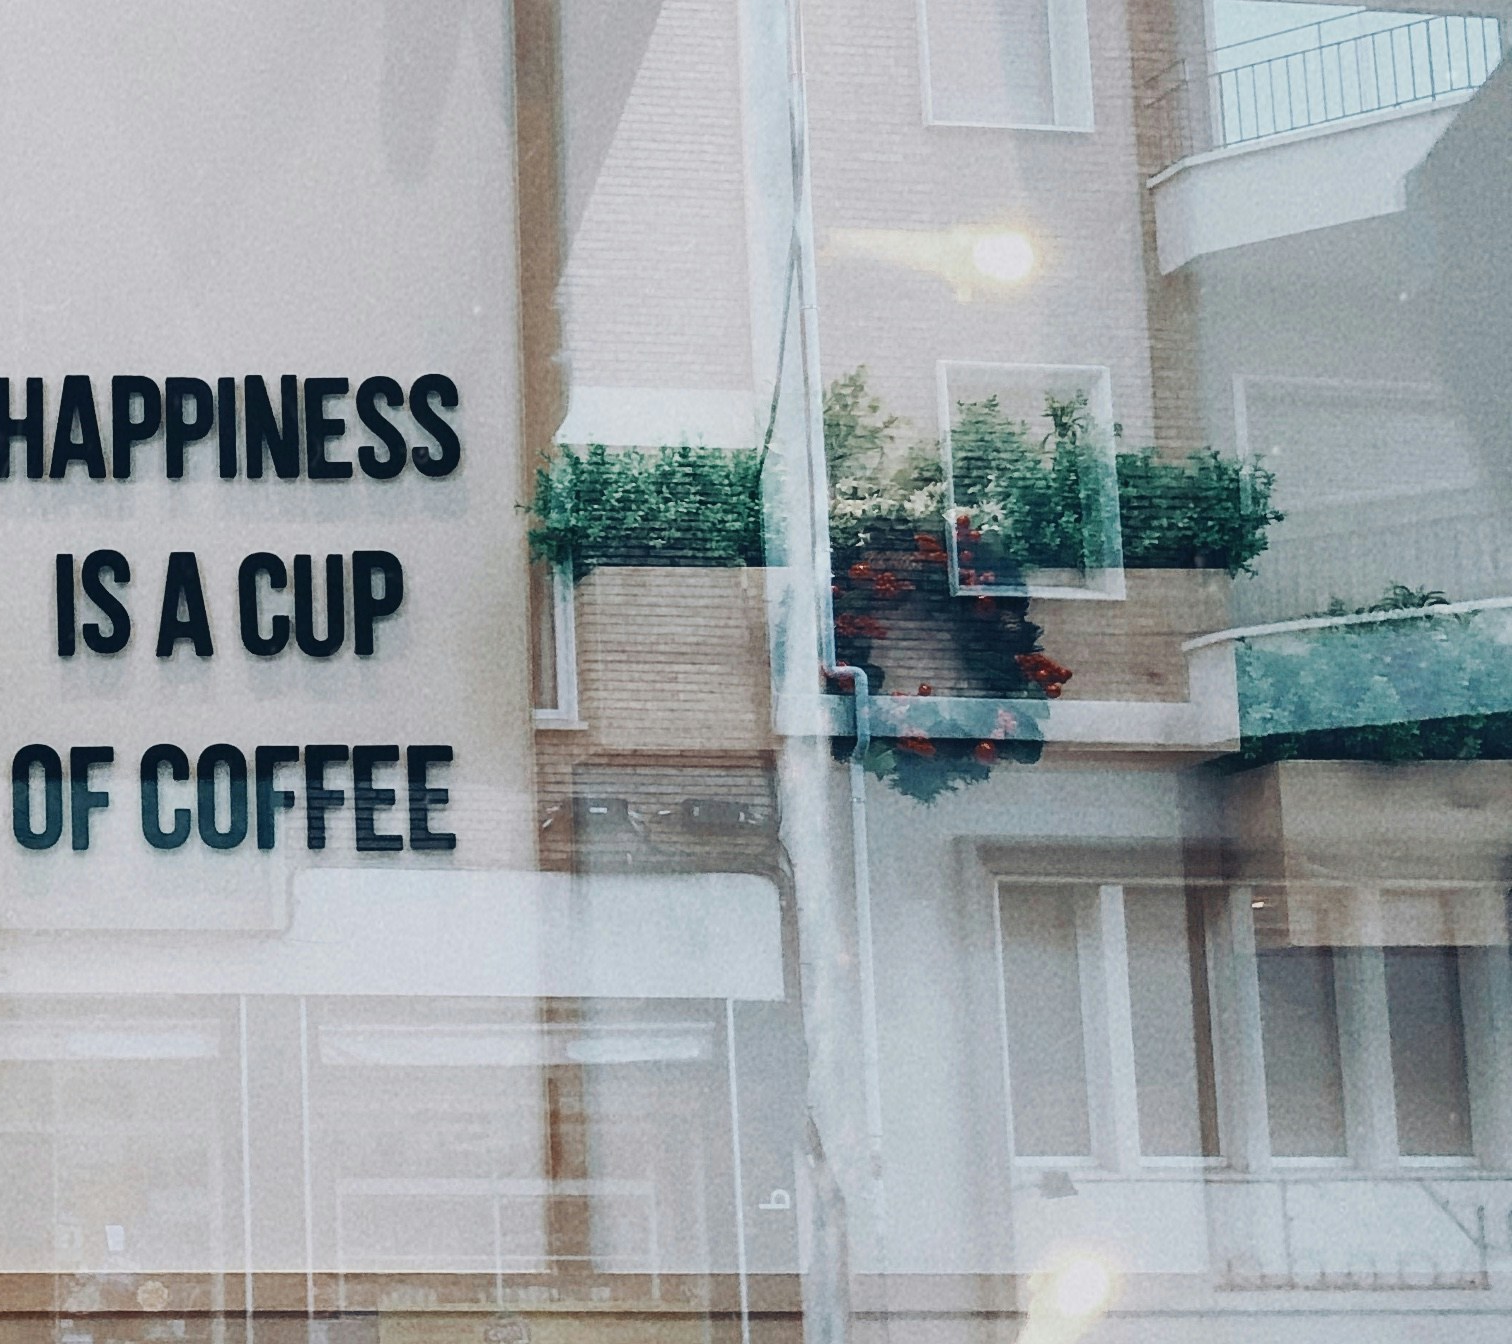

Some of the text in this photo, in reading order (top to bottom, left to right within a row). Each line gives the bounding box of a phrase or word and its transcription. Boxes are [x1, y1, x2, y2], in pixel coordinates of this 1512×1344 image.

[55, 549, 404, 658] IS A CUP
[12, 744, 457, 852] OF COFFEE
